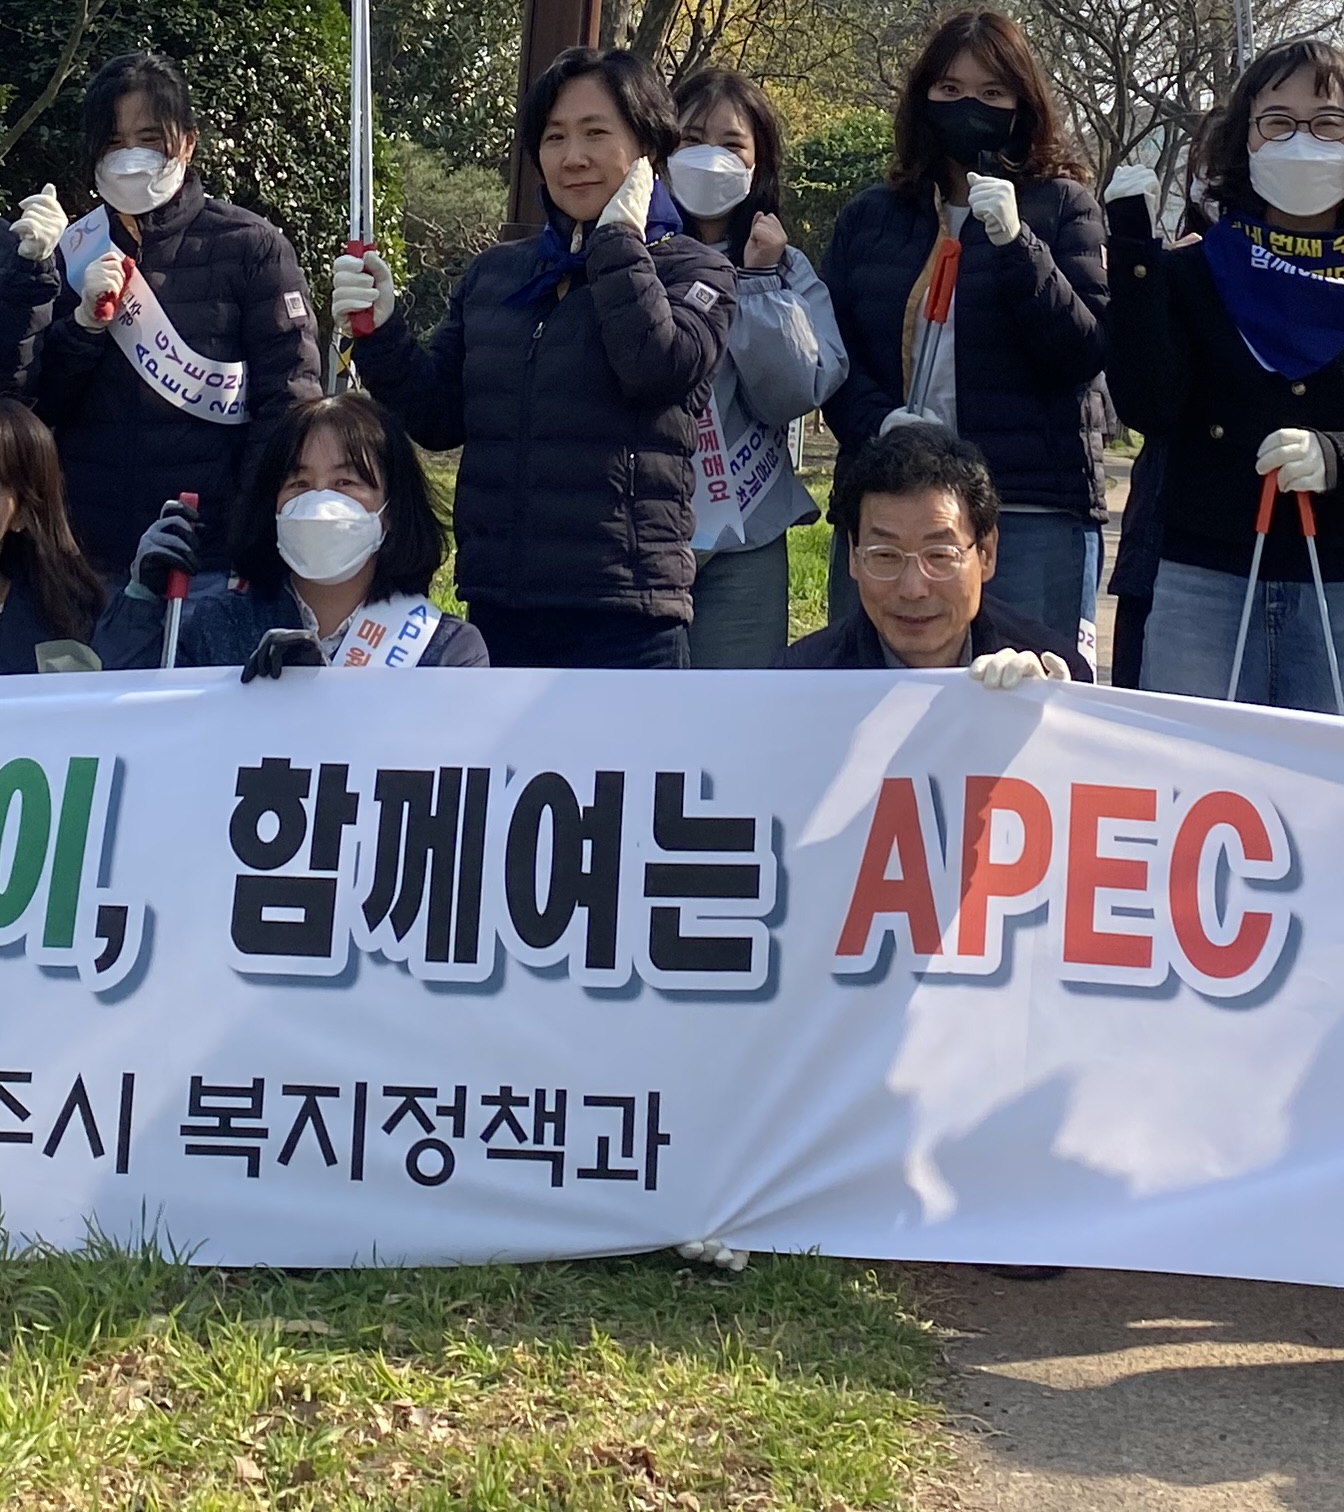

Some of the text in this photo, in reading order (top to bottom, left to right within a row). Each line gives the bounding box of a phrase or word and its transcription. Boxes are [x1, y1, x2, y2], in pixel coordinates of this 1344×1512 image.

[136, 343, 202, 405] APEC
[385, 604, 428, 668] APE
[229, 757, 761, 973] 함께여는
[835, 776, 1274, 981] APEC
[179, 1075, 671, 1191] 복지정책과
